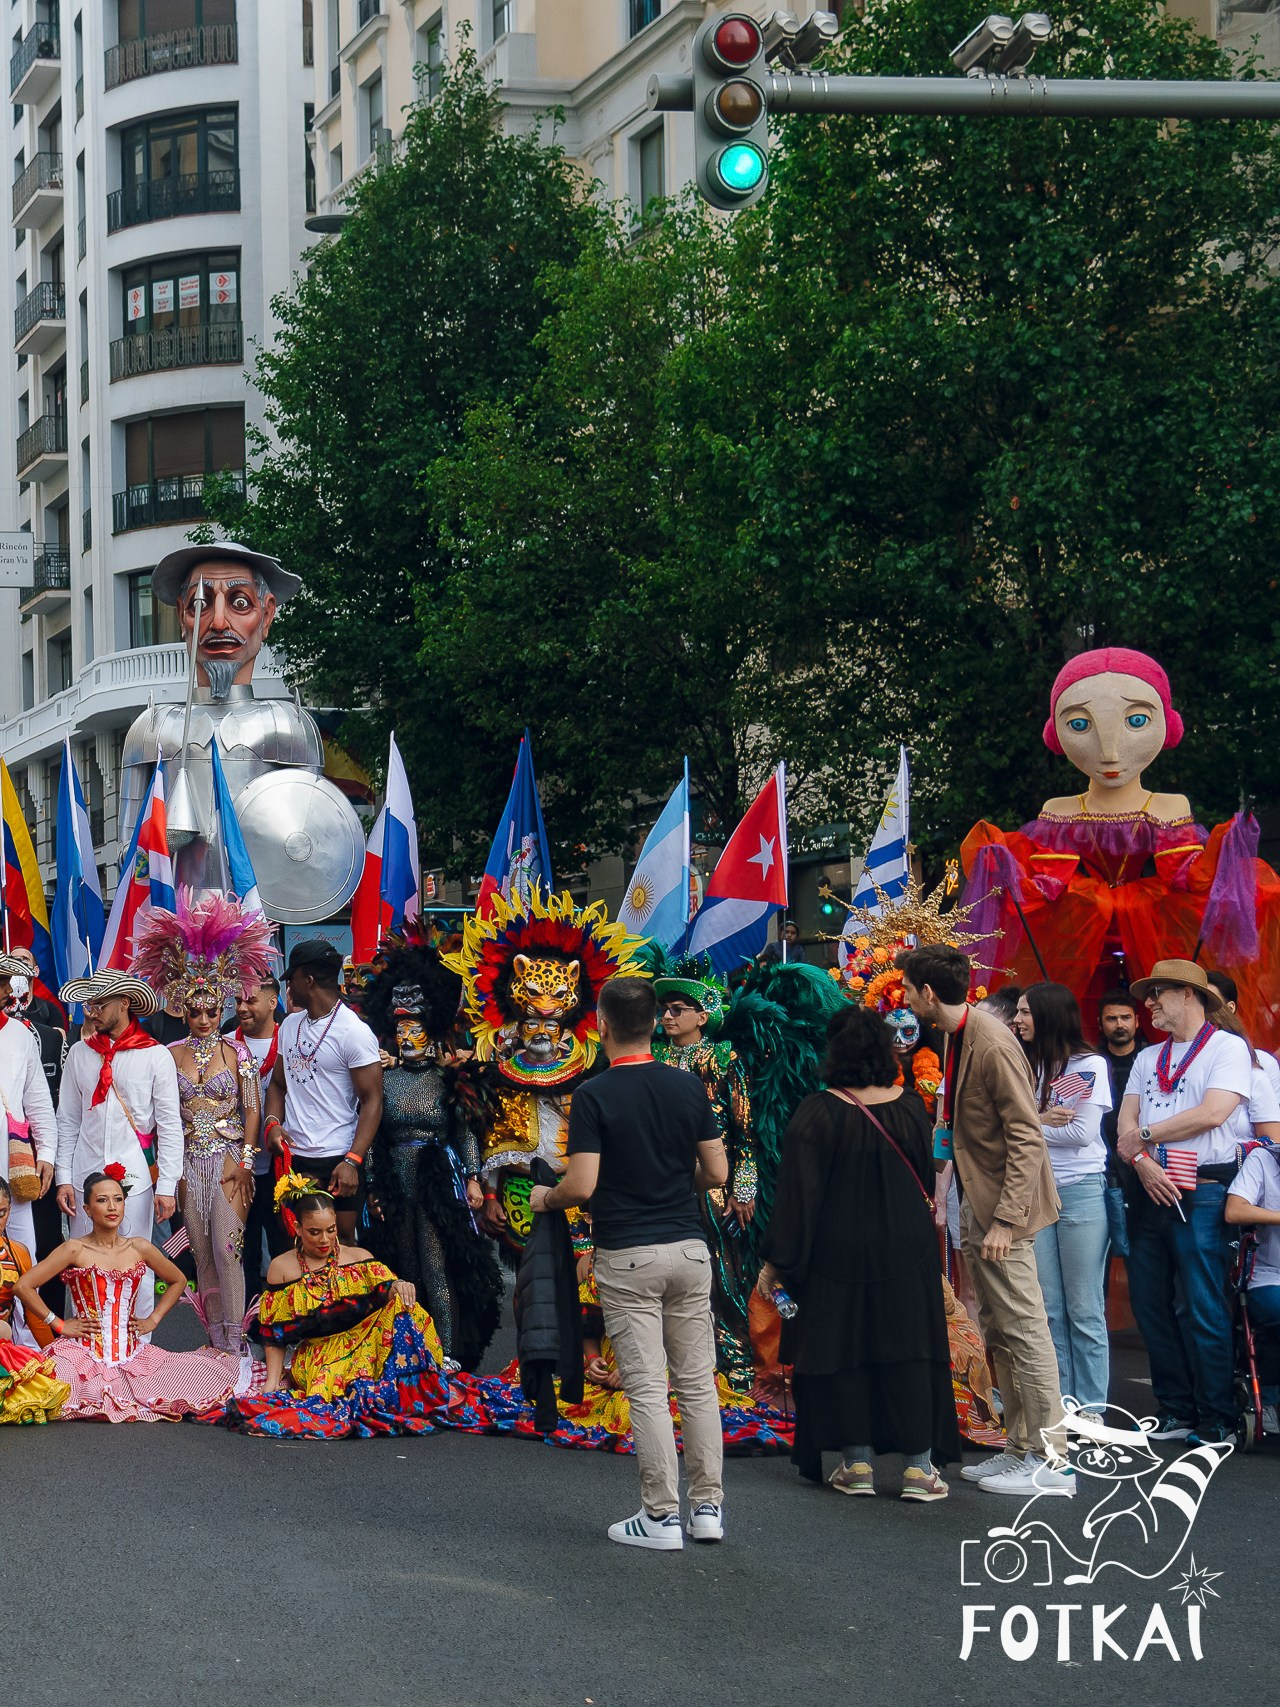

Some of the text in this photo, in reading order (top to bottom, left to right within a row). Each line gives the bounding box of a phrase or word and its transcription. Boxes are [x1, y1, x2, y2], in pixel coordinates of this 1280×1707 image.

[0, 542, 28, 550] Rincón
[288, 930, 346, 941] Too Faced
